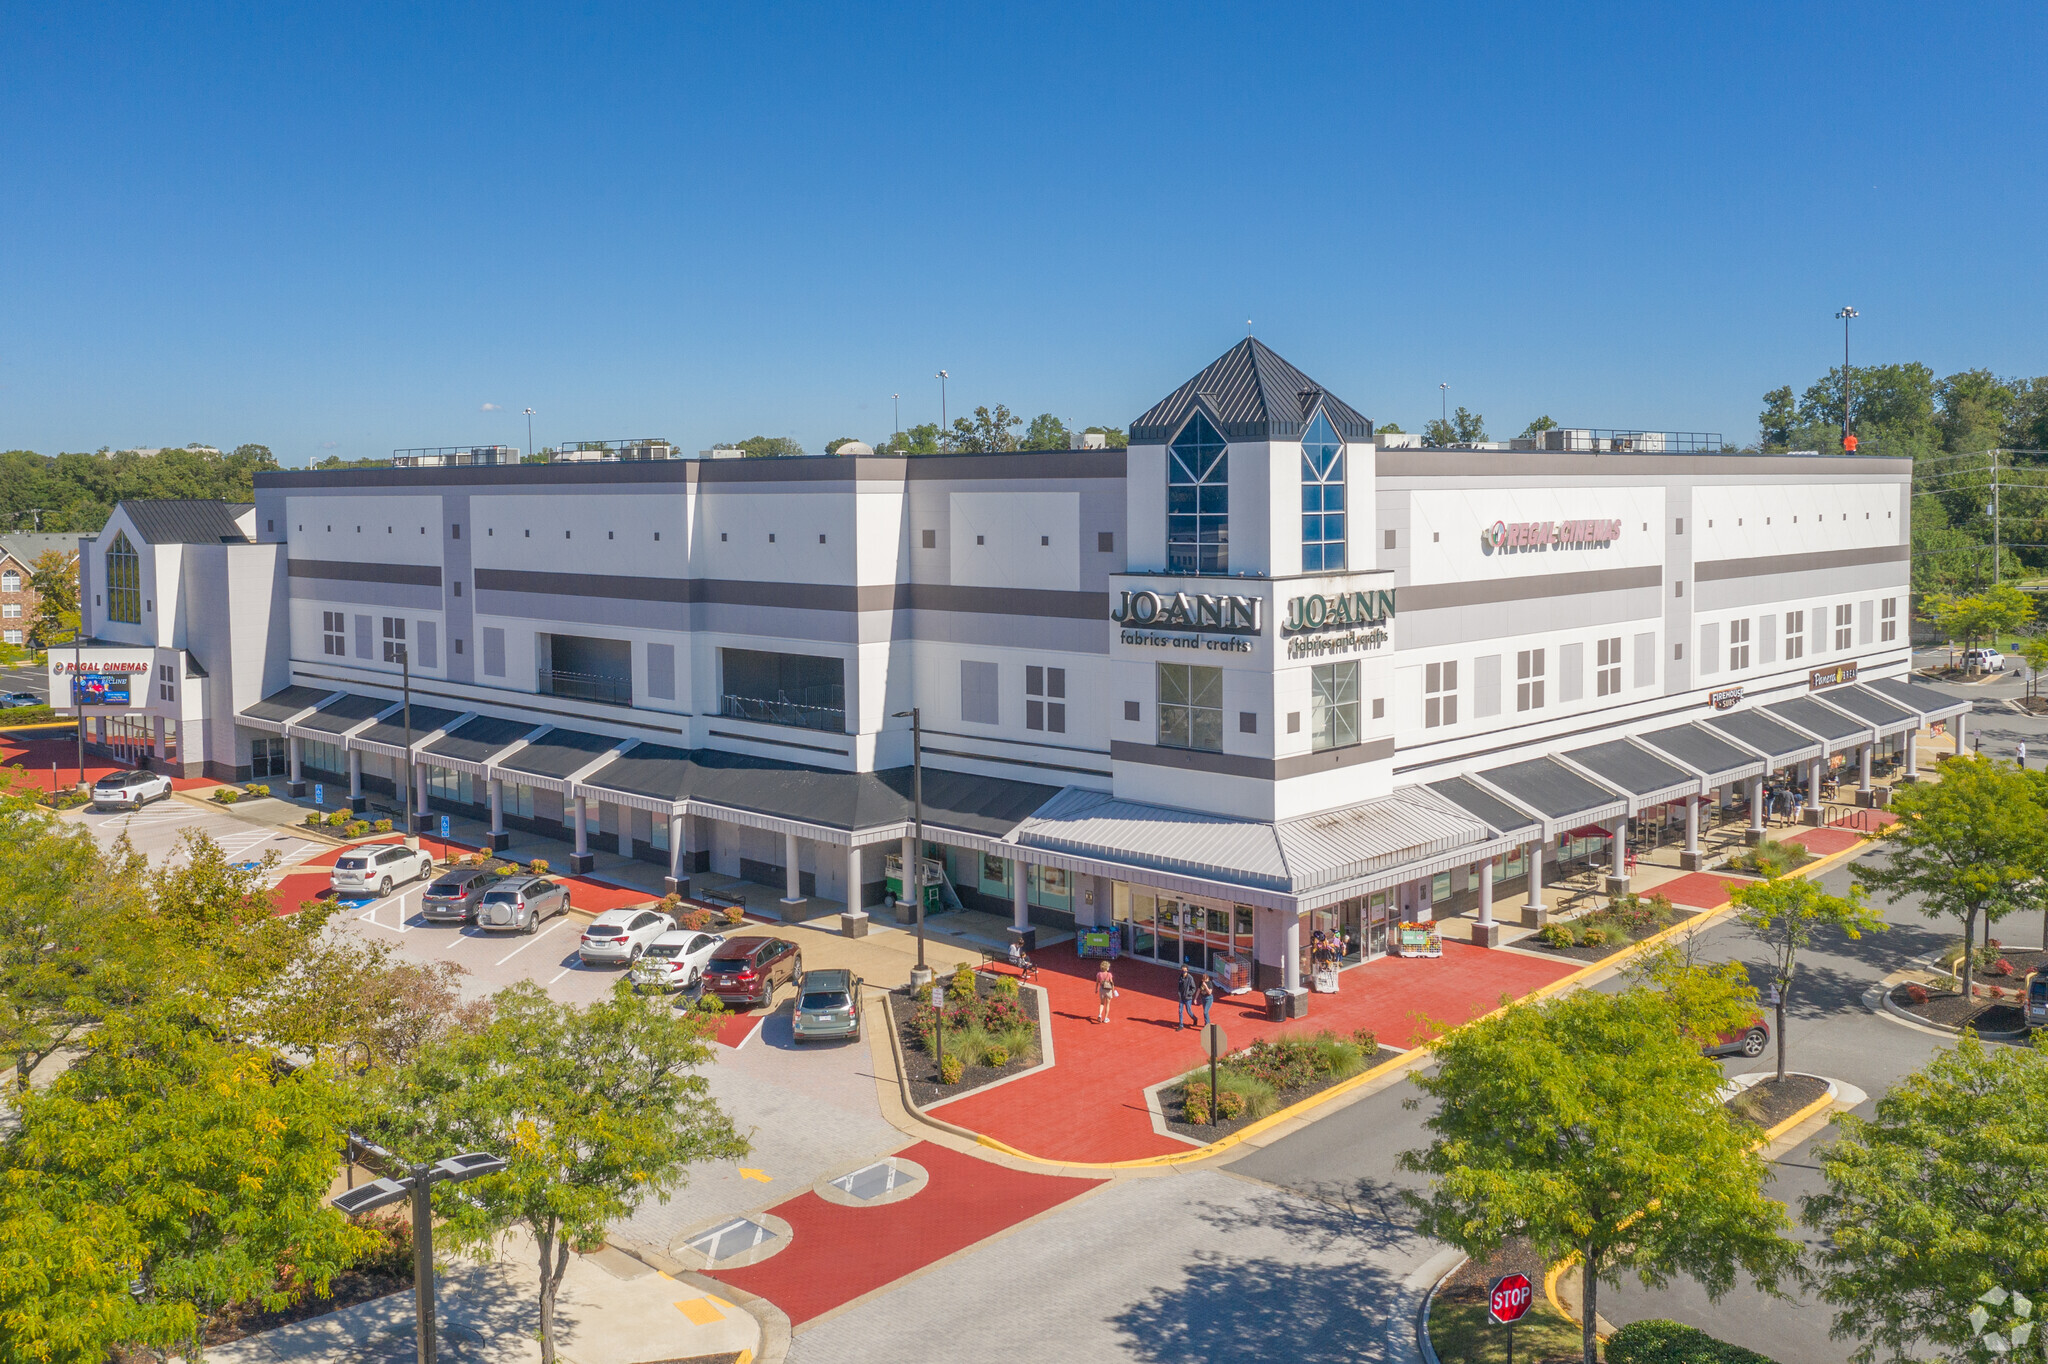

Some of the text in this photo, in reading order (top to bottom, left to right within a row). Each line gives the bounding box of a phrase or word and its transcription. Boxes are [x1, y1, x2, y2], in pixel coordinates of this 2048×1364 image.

[1507, 519, 1622, 546] REGAL CINEMAS
[1120, 630, 1249, 652] fabrics and crafts
[1295, 629, 1388, 652] fabrics and crafts
[103, 662, 148, 671] CINEMAS
[1814, 669, 1859, 687] Panera BREA
[1712, 688, 1744, 705] FIREHOUSE
[1722, 699, 1735, 708] SUBS
[1493, 1286, 1530, 1310] STOP
